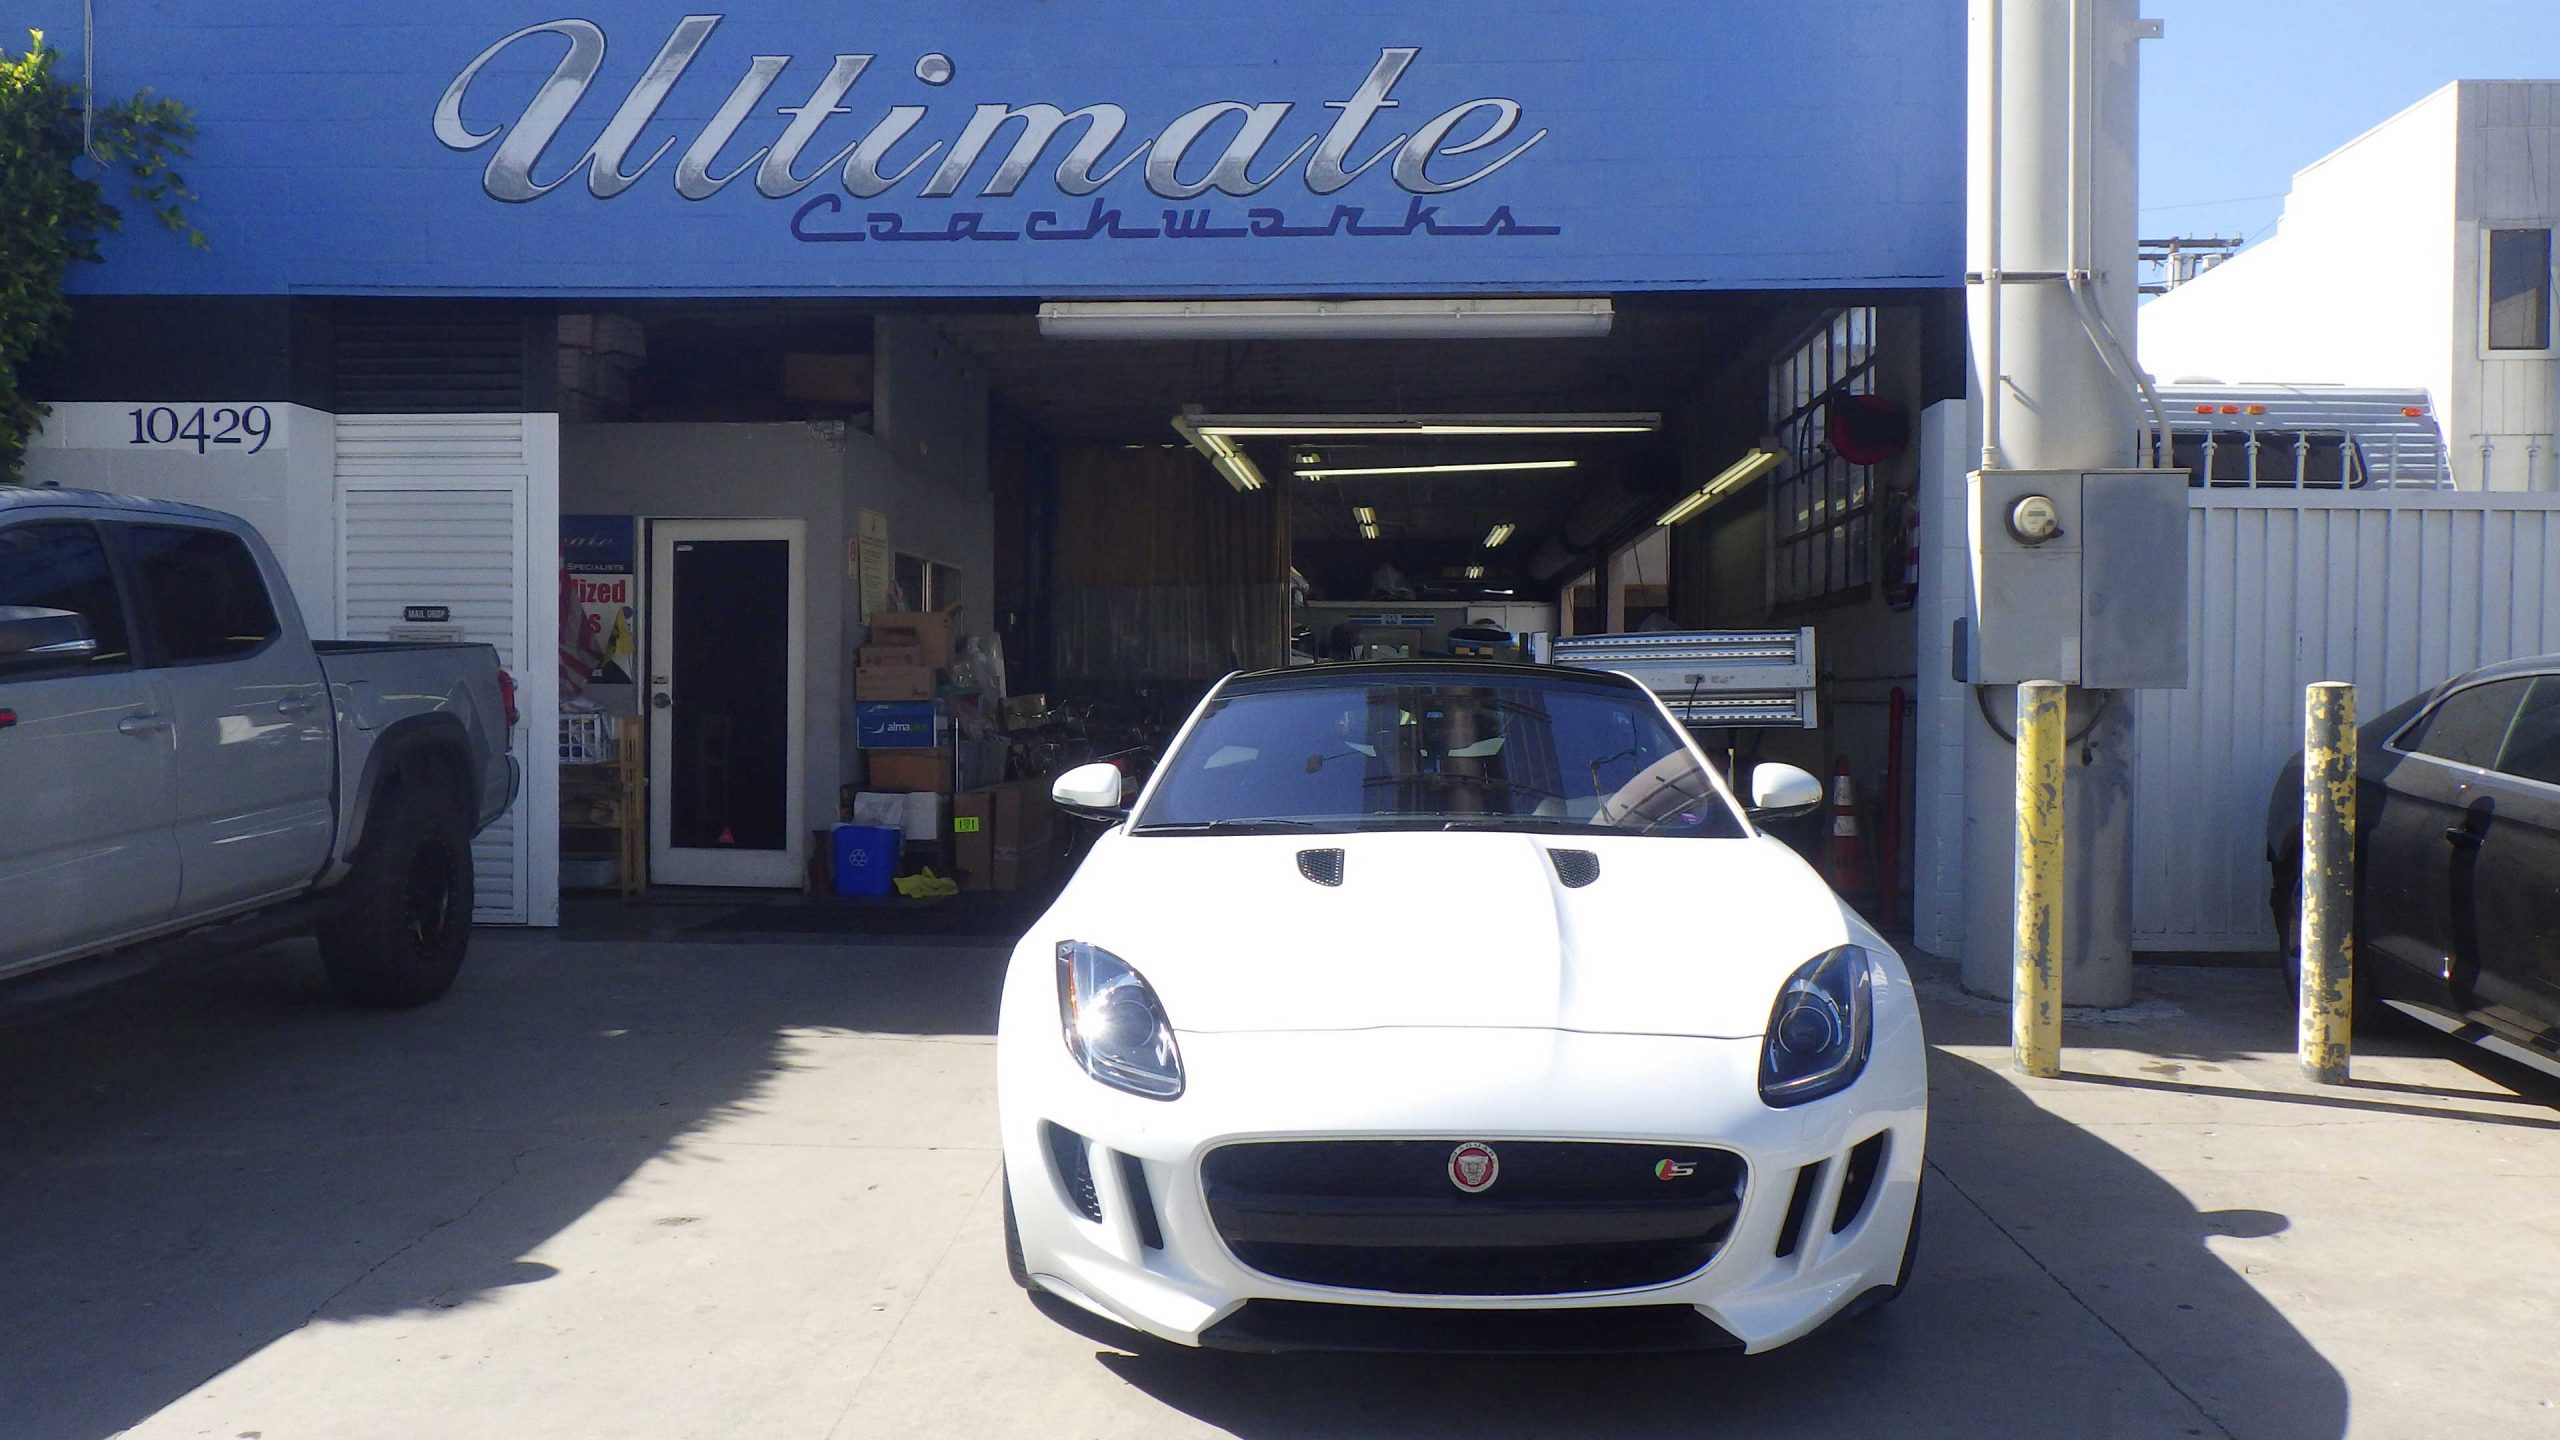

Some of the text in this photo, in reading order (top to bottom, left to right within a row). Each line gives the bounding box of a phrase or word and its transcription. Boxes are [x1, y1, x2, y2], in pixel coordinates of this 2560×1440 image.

[432, 14, 1547, 203] Ultimate
[790, 193, 1561, 243] Coachworks
[128, 405, 271, 455] 10429
[567, 563, 625, 571] SPECIALISTS
[408, 609, 426, 619] MAIL
